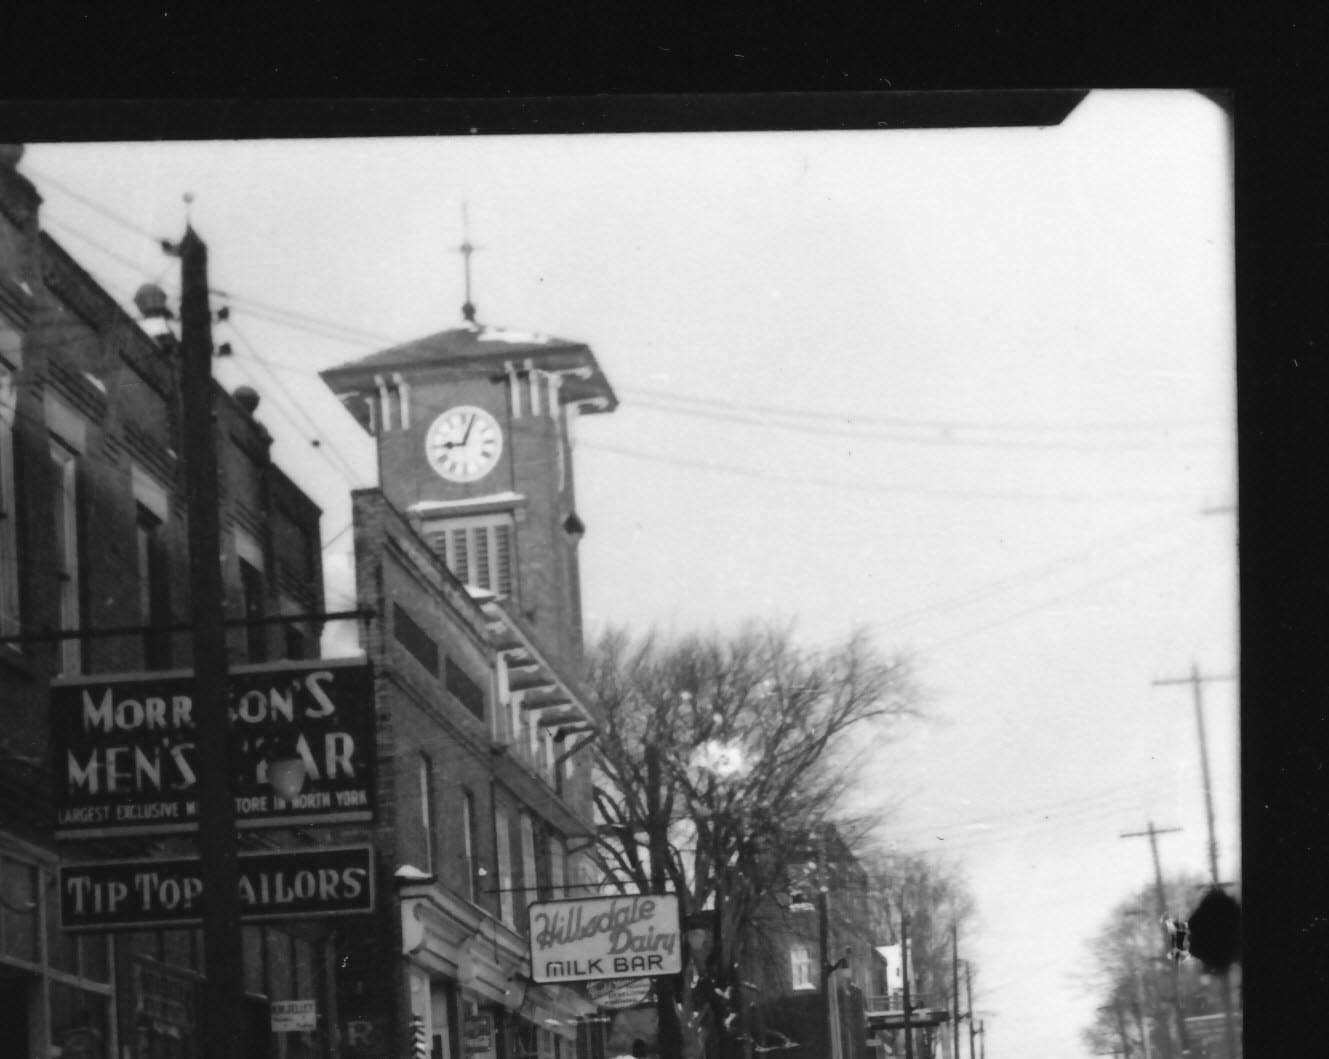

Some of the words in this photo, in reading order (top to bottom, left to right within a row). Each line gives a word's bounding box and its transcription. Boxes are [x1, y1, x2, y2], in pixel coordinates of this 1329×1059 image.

[81, 671, 337, 734] MORRON'S
[66, 735, 198, 796] MEN'S
[58, 805, 110, 825] LARGEST
[115, 801, 179, 821] EXCLUSIVE
[234, 795, 268, 814] TORE
[292, 791, 331, 809] NORTH
[336, 789, 368, 807] YORK
[67, 875, 128, 915] TIP
[134, 871, 203, 913] TOP
[237, 867, 367, 907] AILORS
[534, 897, 656, 951] Hillsdale
[607, 924, 677, 957] Dairy
[545, 957, 604, 978] MILK
[613, 954, 664, 974] BAR
